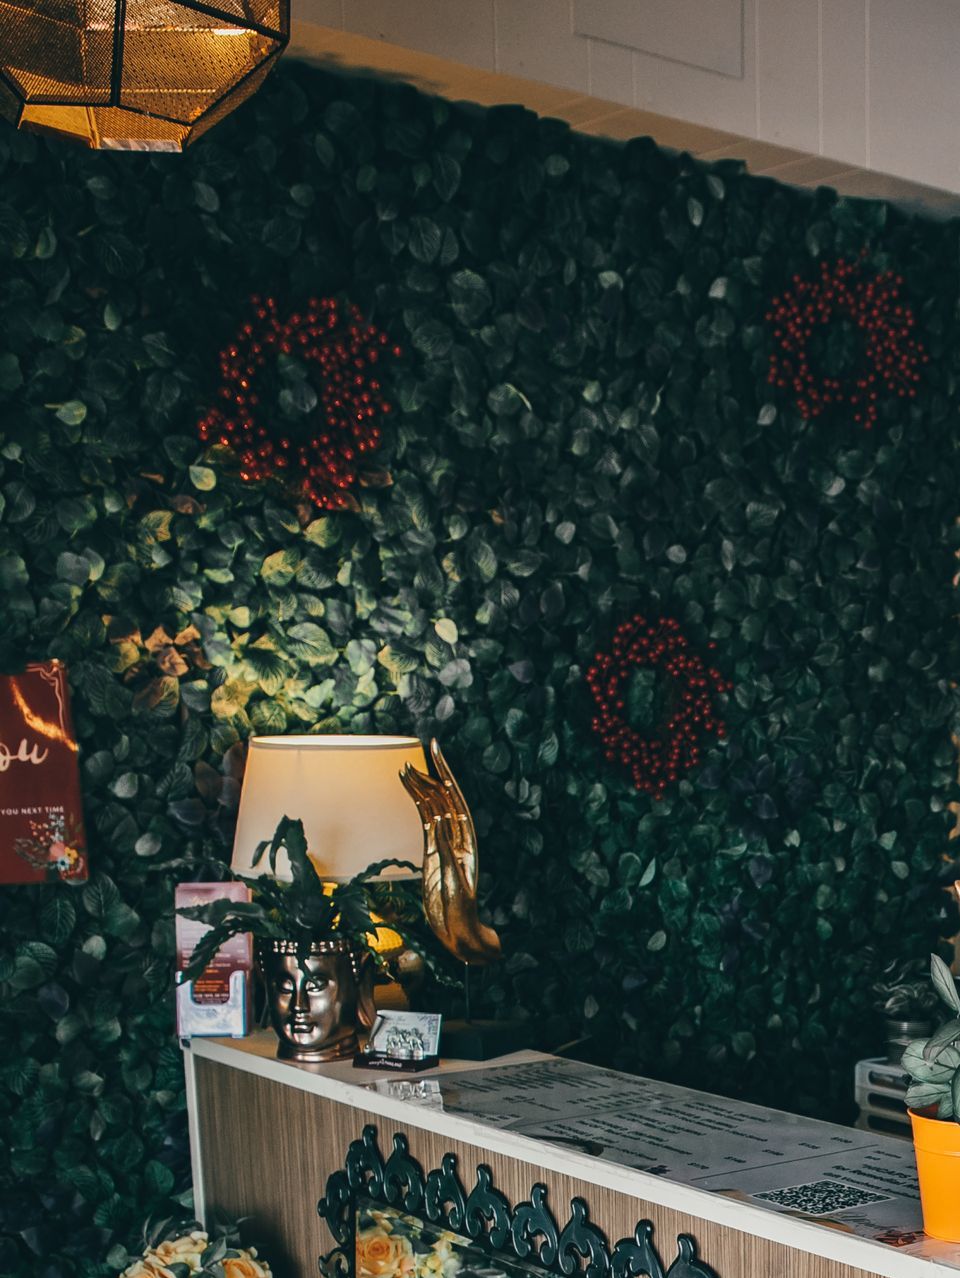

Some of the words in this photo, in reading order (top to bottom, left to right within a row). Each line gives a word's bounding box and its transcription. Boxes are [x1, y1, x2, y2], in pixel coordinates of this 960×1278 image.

[1, 807, 19, 815] YOU
[21, 806, 42, 815] NEXT
[45, 805, 64, 814] TIME
